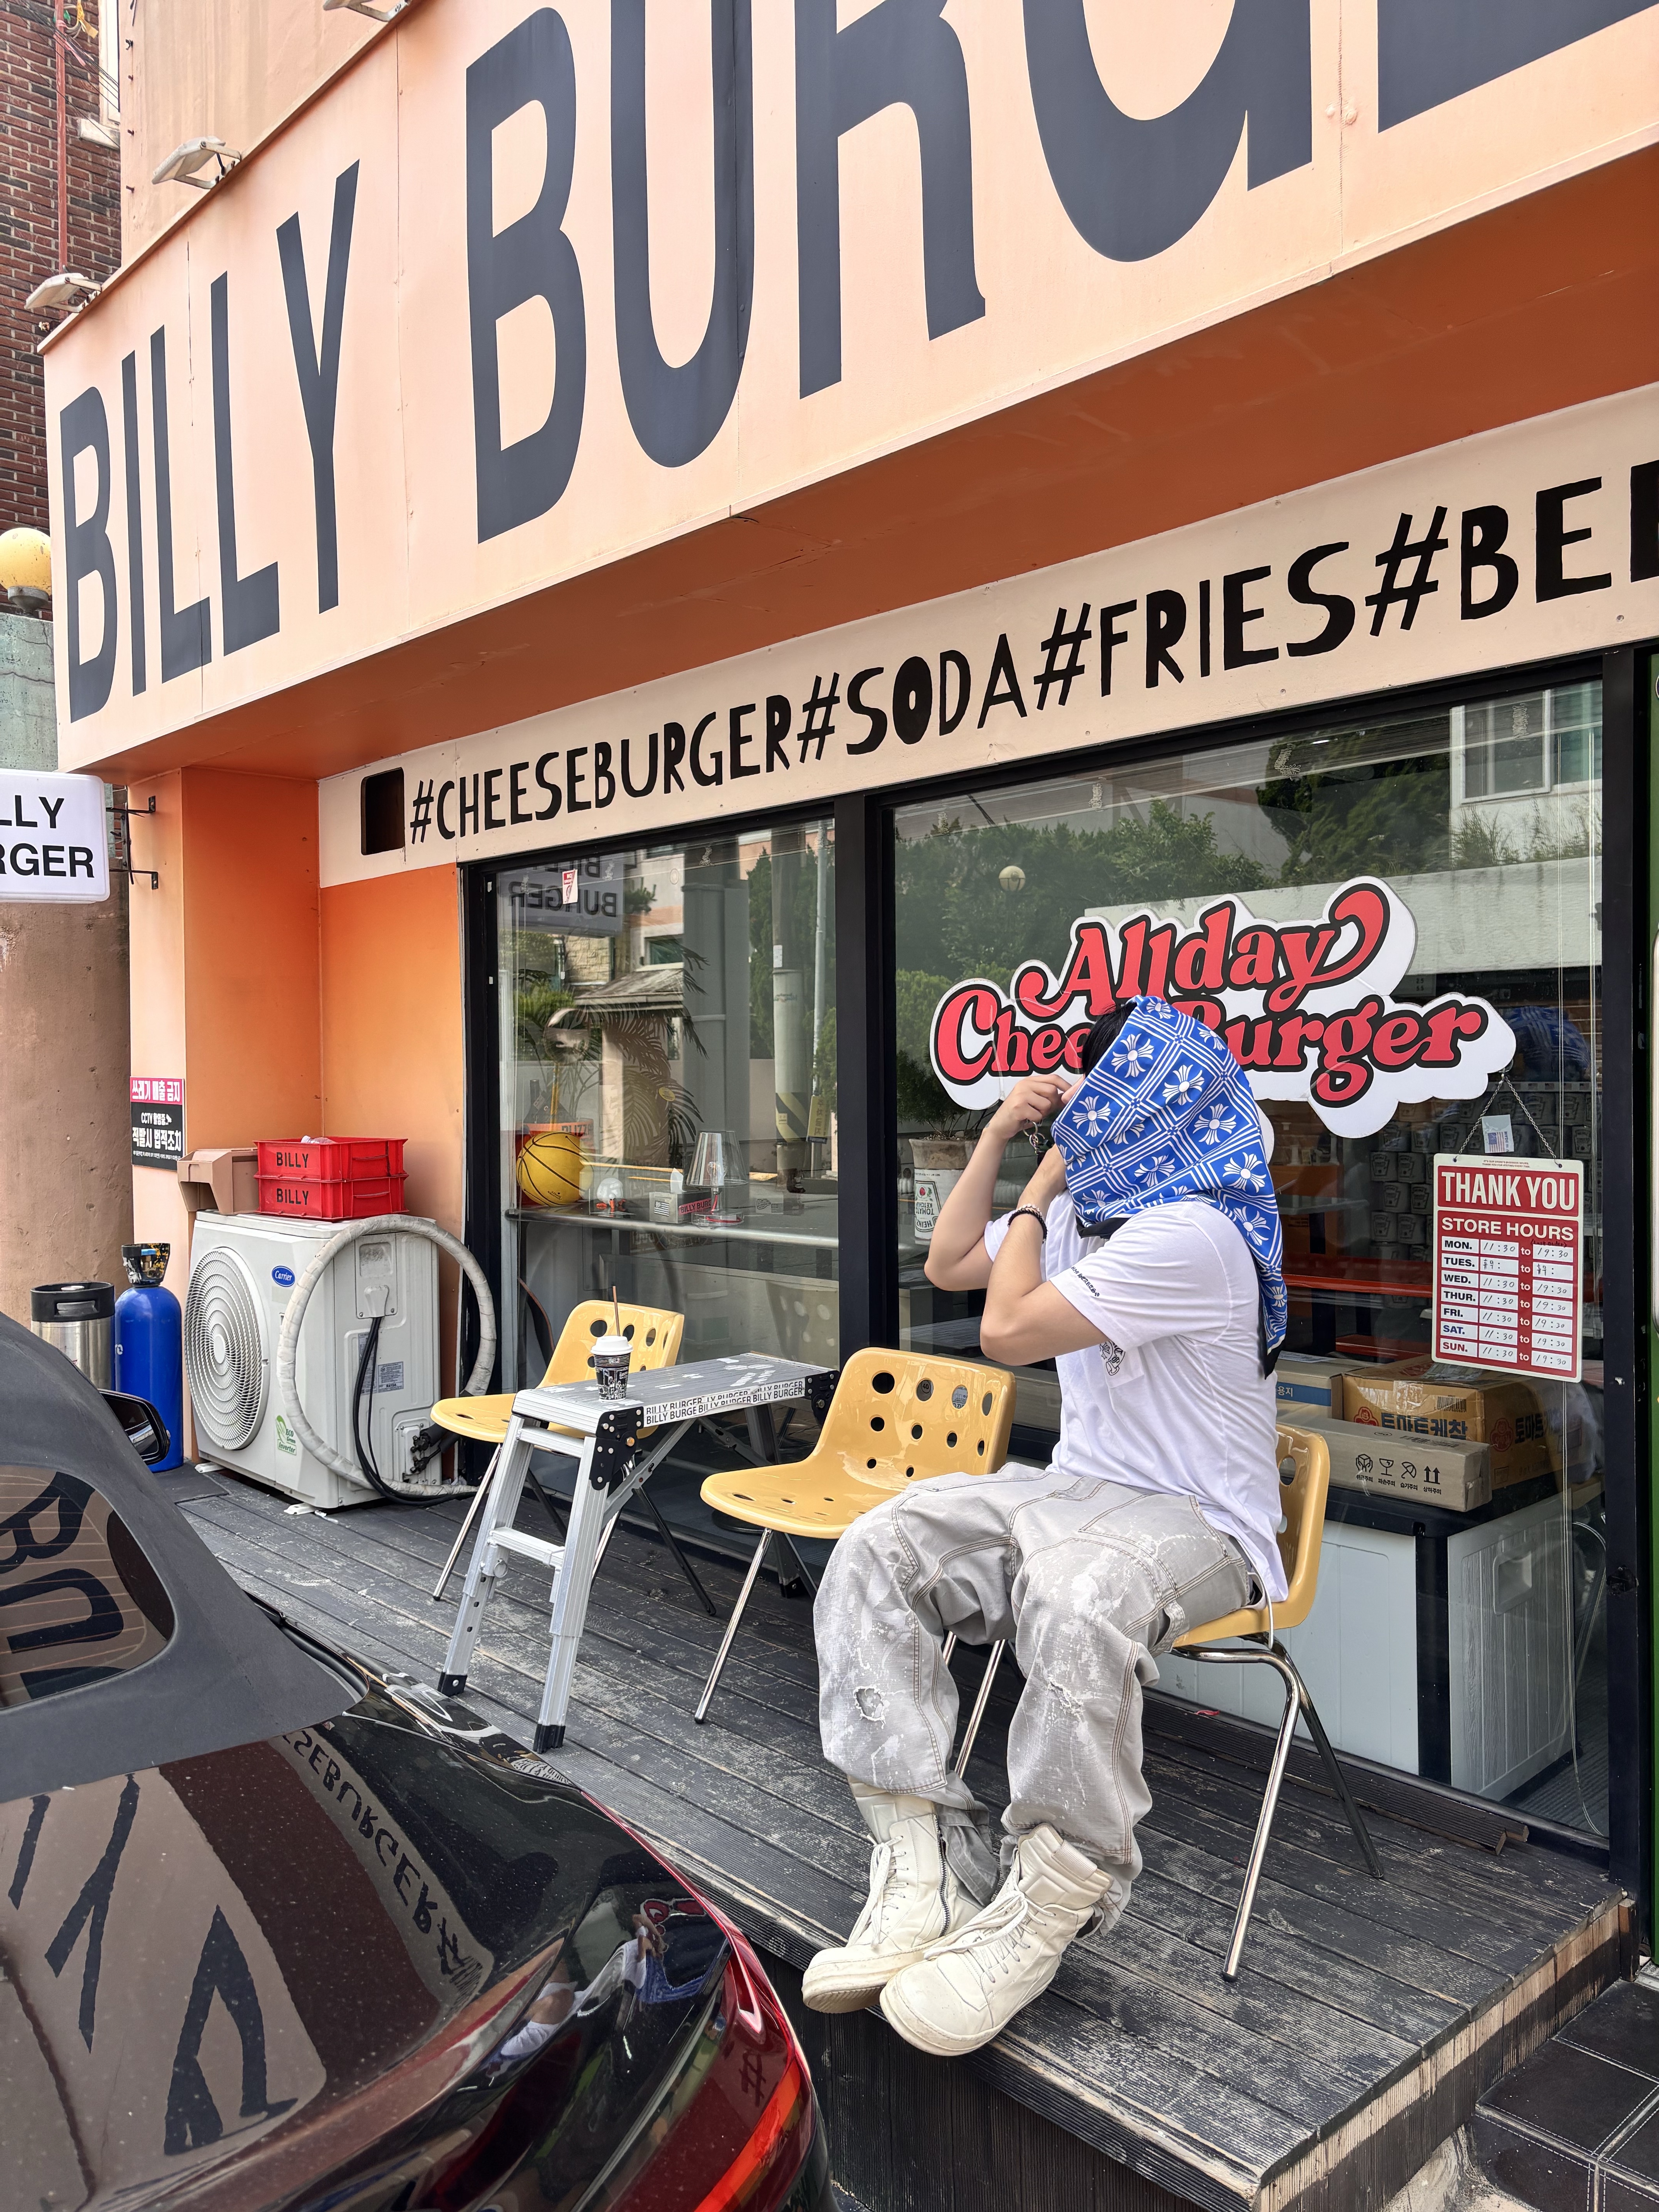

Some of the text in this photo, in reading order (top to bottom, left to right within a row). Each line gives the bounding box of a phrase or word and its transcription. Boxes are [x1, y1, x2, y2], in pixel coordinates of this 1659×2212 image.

[60, 160, 360, 723] BILLY
[0, 795, 65, 829] LY
[1015, 882, 1390, 1022] Allday
[132, 1080, 180, 1102] 쓰레기 배출 금지
[141, 1112, 153, 1124] CCTV
[132, 1127, 181, 1152] 적발시 법적조치
[276, 1152, 309, 1168] BILLY
[276, 1188, 309, 1205] BILLY
[1441, 1171, 1575, 1211] THANK YOU
[680, 1204, 696, 1213] BILLY
[1442, 1217, 1574, 1241] STORE HOURS
[1444, 1240, 1472, 1250] MON.
[1520, 1247, 1531, 1255] to
[1444, 1257, 1475, 1267] TUES.
[1520, 1264, 1530, 1273] to
[275, 1270, 292, 1281] Carrier
[1444, 1274, 1471, 1284] WED.
[1520, 1283, 1530, 1291] to
[1443, 1291, 1475, 1302] THUR.
[1520, 1300, 1530, 1308] to
[1443, 1308, 1463, 1317] FRI.
[1520, 1317, 1530, 1326] to
[1443, 1325, 1465, 1334] SAT.
[1519, 1335, 1530, 1343] to
[1443, 1341, 1468, 1352] SUN.
[1519, 1352, 1529, 1361] to
[1275, 1386, 1293, 1397] 용지
[646, 1412, 668, 1425] BILLY
[753, 1392, 772, 1403] BILLY
[774, 1387, 803, 1399] BURGER
[285, 1429, 294, 1437] ECO
[279, 1442, 295, 1453] Inverter
[1378, 1478, 1395, 1487] 파손주의
[1423, 1486, 1441, 1495] 상하주의
